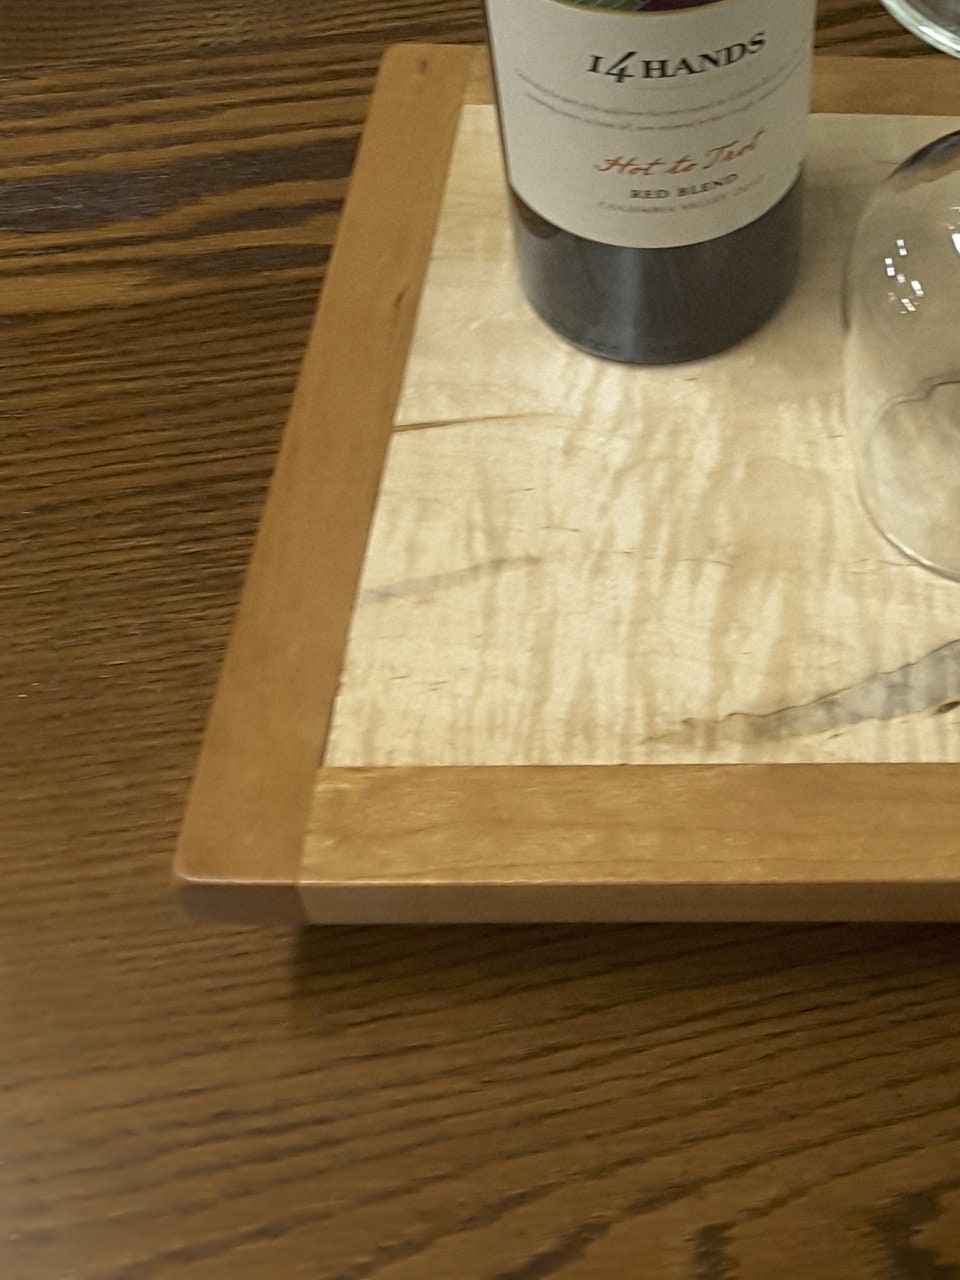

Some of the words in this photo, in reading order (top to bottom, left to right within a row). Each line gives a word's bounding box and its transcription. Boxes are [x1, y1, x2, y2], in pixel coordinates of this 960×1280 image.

[586, 49, 638, 84] 14
[640, 31, 767, 80] HANDS
[594, 155, 666, 176] Hot
[666, 154, 698, 176] to
[702, 125, 767, 170] Trot
[629, 188, 671, 200] RED
[676, 172, 740, 198] BLEND
